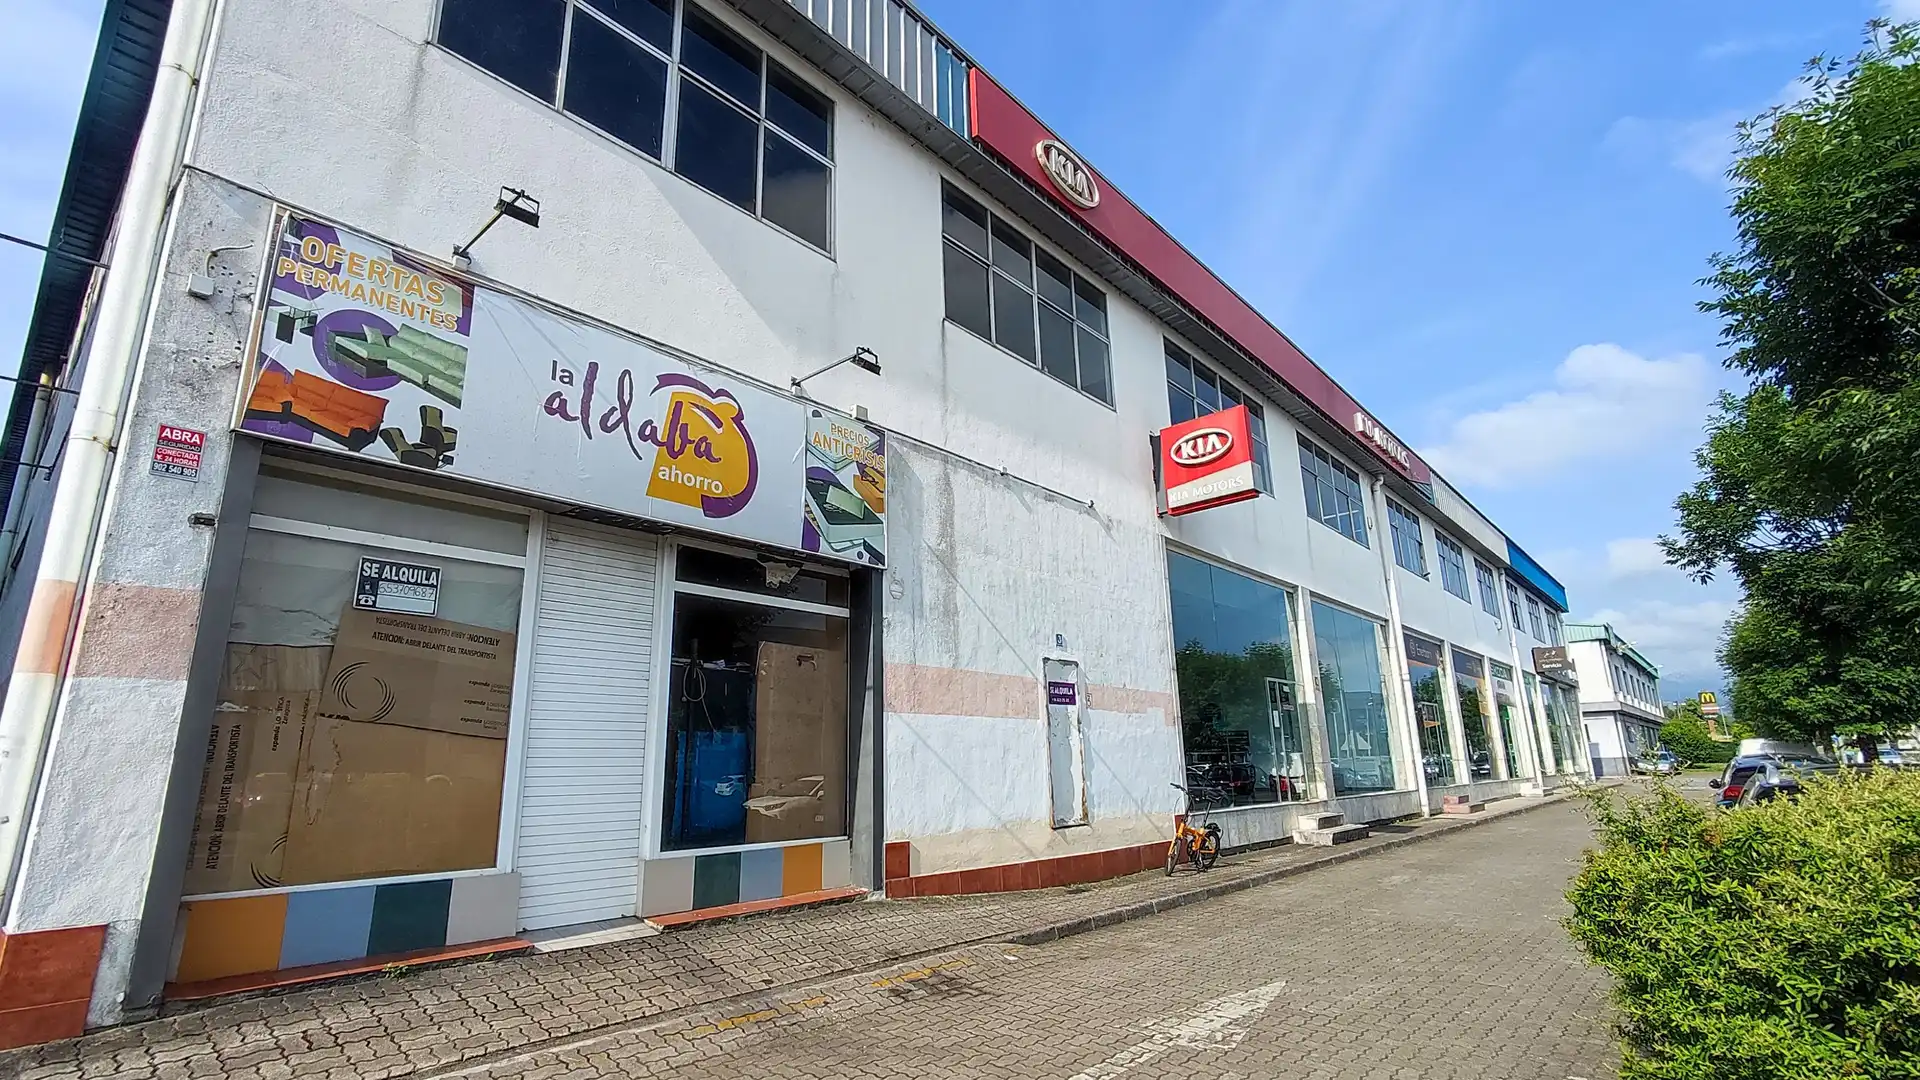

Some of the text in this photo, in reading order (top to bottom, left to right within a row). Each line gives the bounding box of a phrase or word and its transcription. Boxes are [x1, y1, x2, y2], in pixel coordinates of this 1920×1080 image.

[1047, 146, 1092, 201] KIA
[301, 236, 446, 305] OFERTAS
[277, 257, 458, 332] PERMANENTES
[551, 359, 575, 387] la
[543, 361, 723, 464] aldaba
[158, 439, 201, 452] SEGURIDAD
[160, 427, 201, 445] ABRA
[830, 423, 870, 446] PRECIOS
[1179, 433, 1223, 460] KIA
[157, 447, 199, 461] CONECTADA
[164, 455, 173, 463] 24
[173, 457, 198, 467] HORAS
[812, 431, 885, 471] ANTICRISIS
[153, 462, 197, 477] 902 540 905
[657, 464, 725, 494] ahorro
[1169, 476, 1243, 502] KIA MOTORS
[362, 561, 438, 586] SE ALQUILA
[405, 638, 422, 648] ABRIR
[421, 640, 447, 652] DELANTE
[446, 645, 457, 654] DEL
[457, 647, 497, 660] TRANSPORTISTA
[1054, 686, 1073, 695] ALQUILA
[224, 723, 242, 772] TRANSPORTISTA
[271, 726, 282, 752] expanda
[221, 771, 234, 786] DEL
[216, 785, 231, 813] DELANTE
[212, 812, 226, 833] ABRIR
